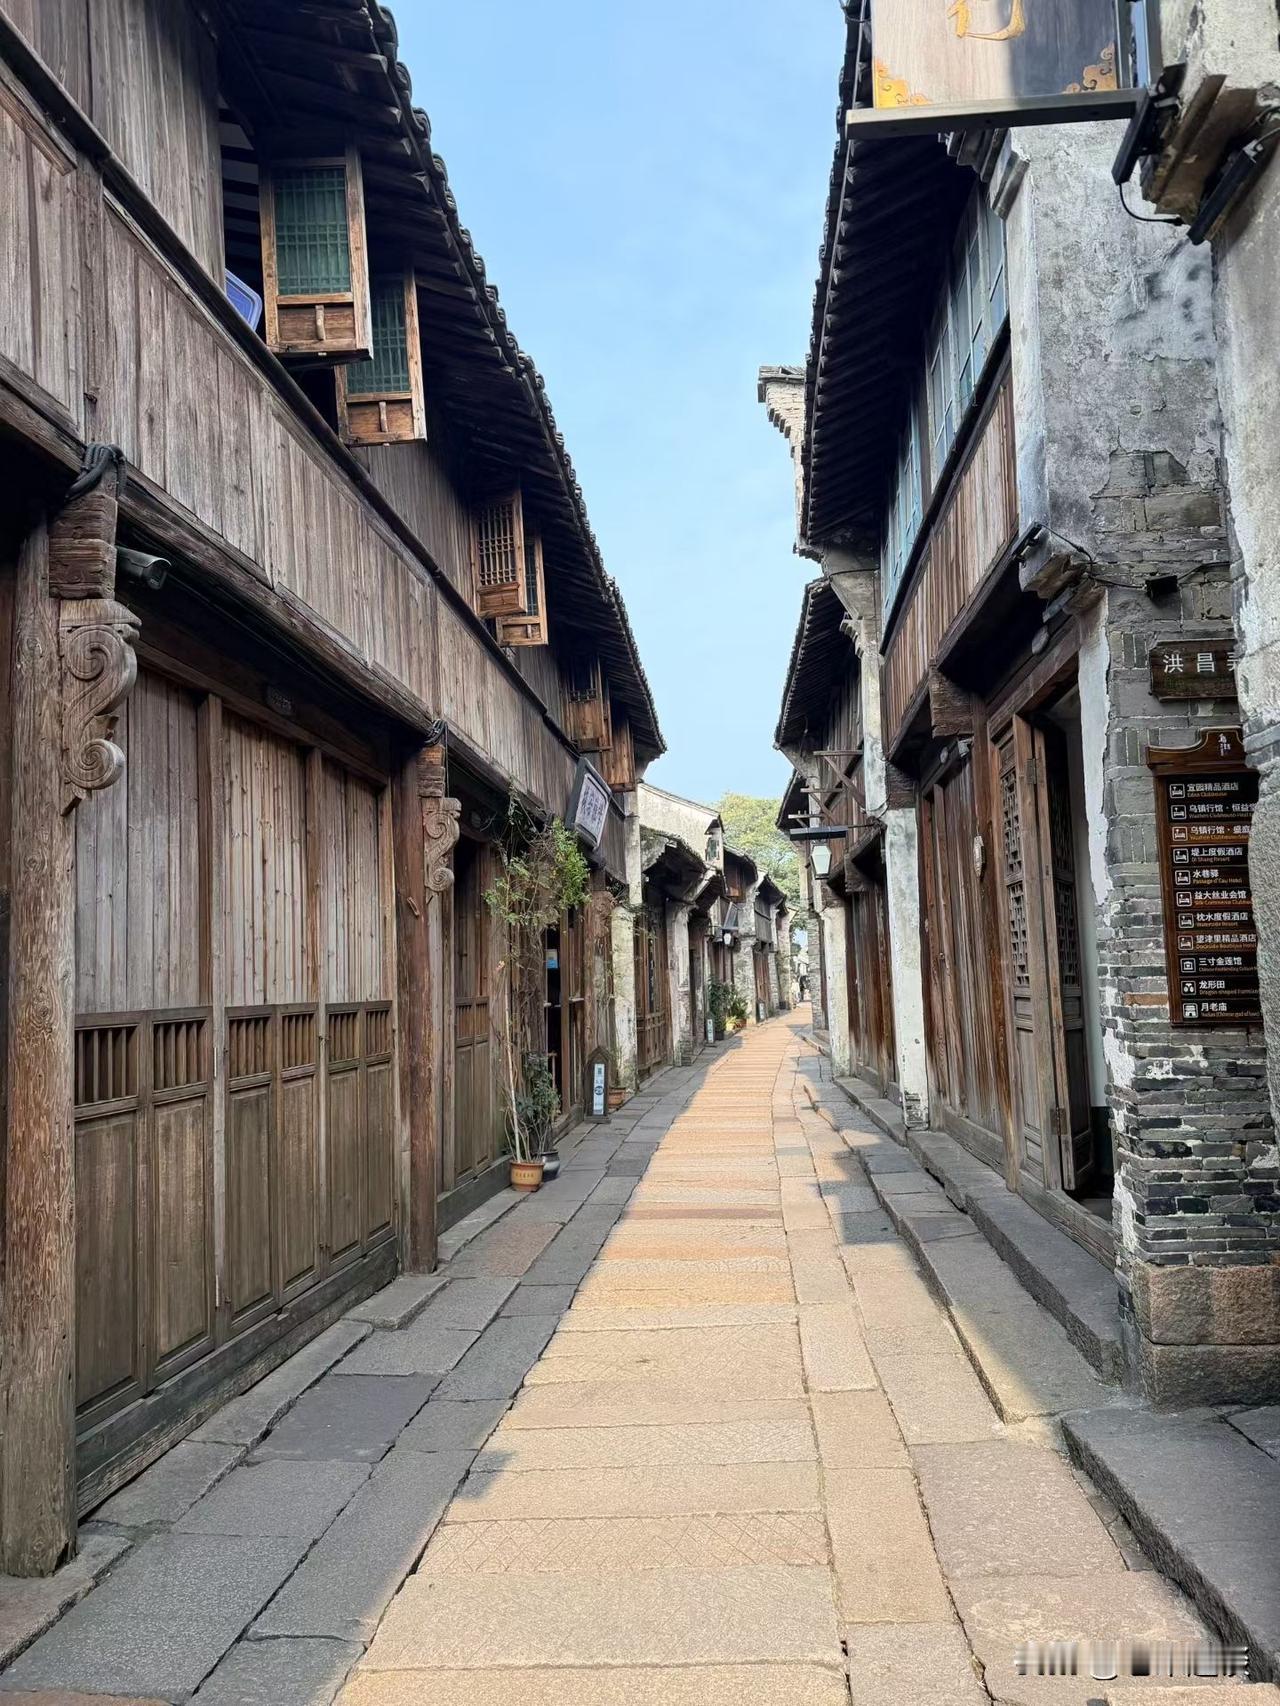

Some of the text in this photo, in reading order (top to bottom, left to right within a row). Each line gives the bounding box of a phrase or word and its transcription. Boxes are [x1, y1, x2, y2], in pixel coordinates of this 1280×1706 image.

[1198, 957, 1242, 965] 三寸金莲馆
[1201, 1003, 1228, 1011] 月老庙
